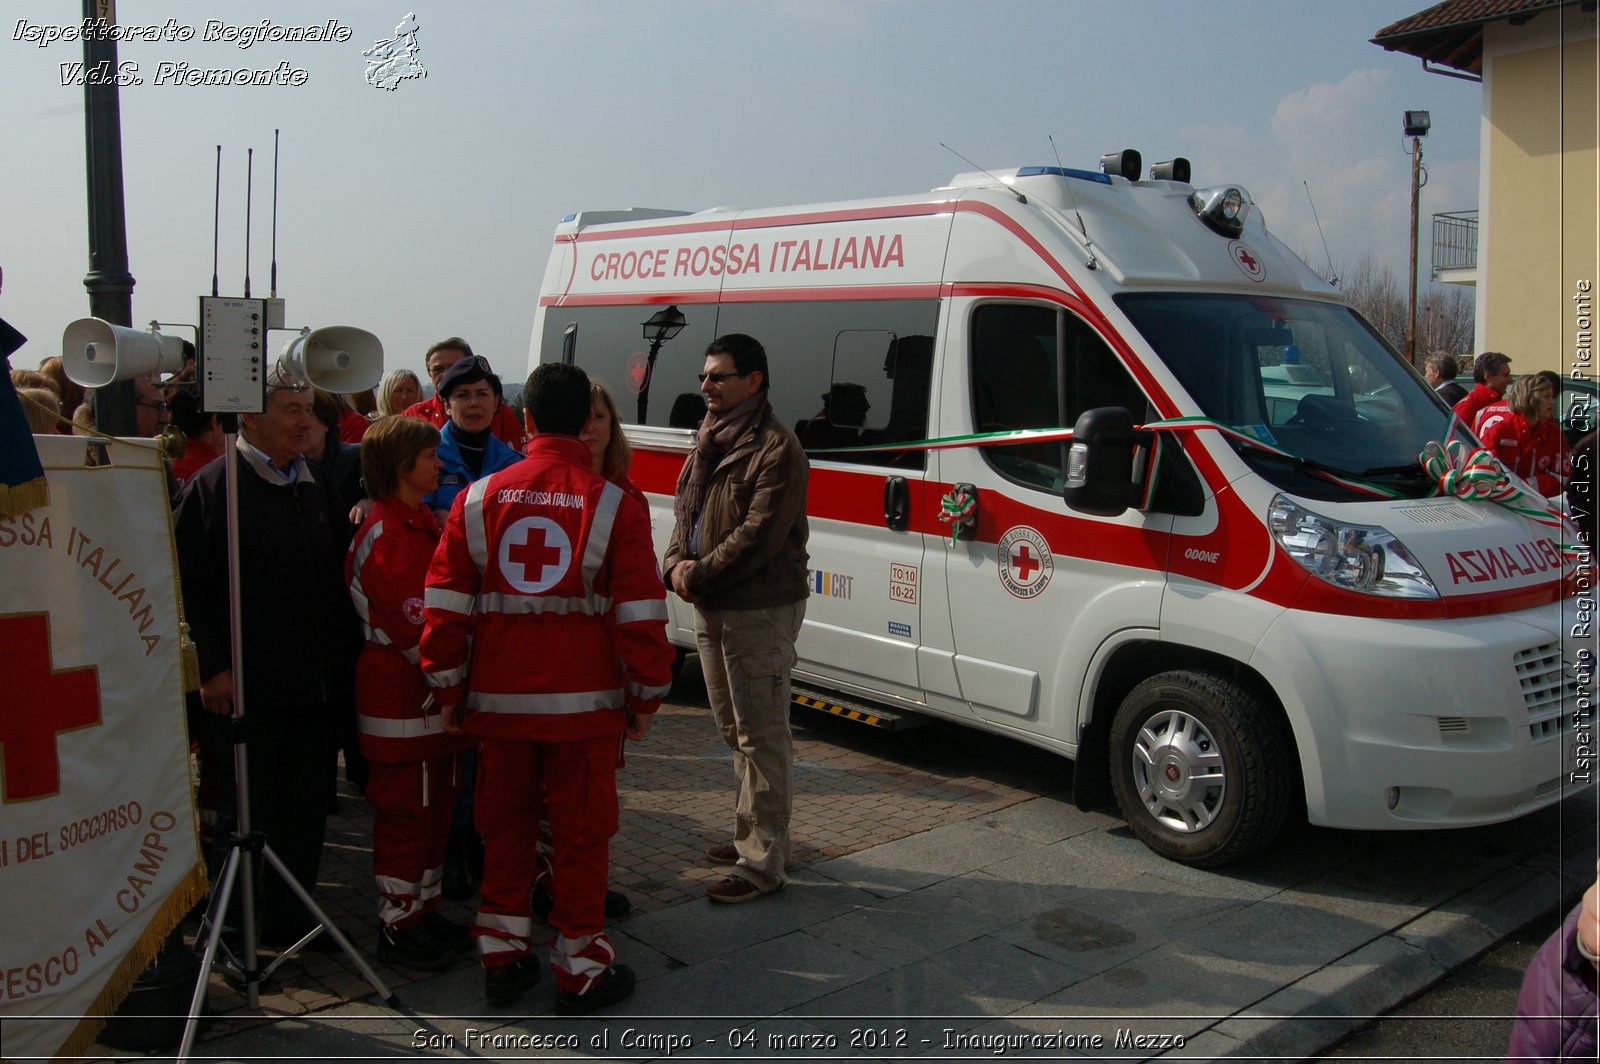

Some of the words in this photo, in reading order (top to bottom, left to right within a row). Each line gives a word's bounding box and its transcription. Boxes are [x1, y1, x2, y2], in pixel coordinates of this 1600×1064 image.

[590, 249, 669, 281] CROCE
[673, 243, 760, 277] ROSSA
[769, 234, 905, 273] ITALIANA
[498, 489, 525, 504] CROCE
[525, 490, 551, 506] ROSSA
[552, 492, 584, 510] ITALIANA
[1010, 530, 1030, 541] ROSSA
[1184, 547, 1220, 563] ODONE
[832, 573, 854, 600] CRT
[893, 567, 903, 580] TO
[905, 570, 915, 583] 10
[67, 527, 160, 656] ITALIANA
[891, 585, 914, 600] 10-22
[16, 831, 54, 864] DEL
[59, 800, 143, 852] SOCCORSO
[85, 918, 119, 958] AL
[116, 810, 177, 914] CAMPO
